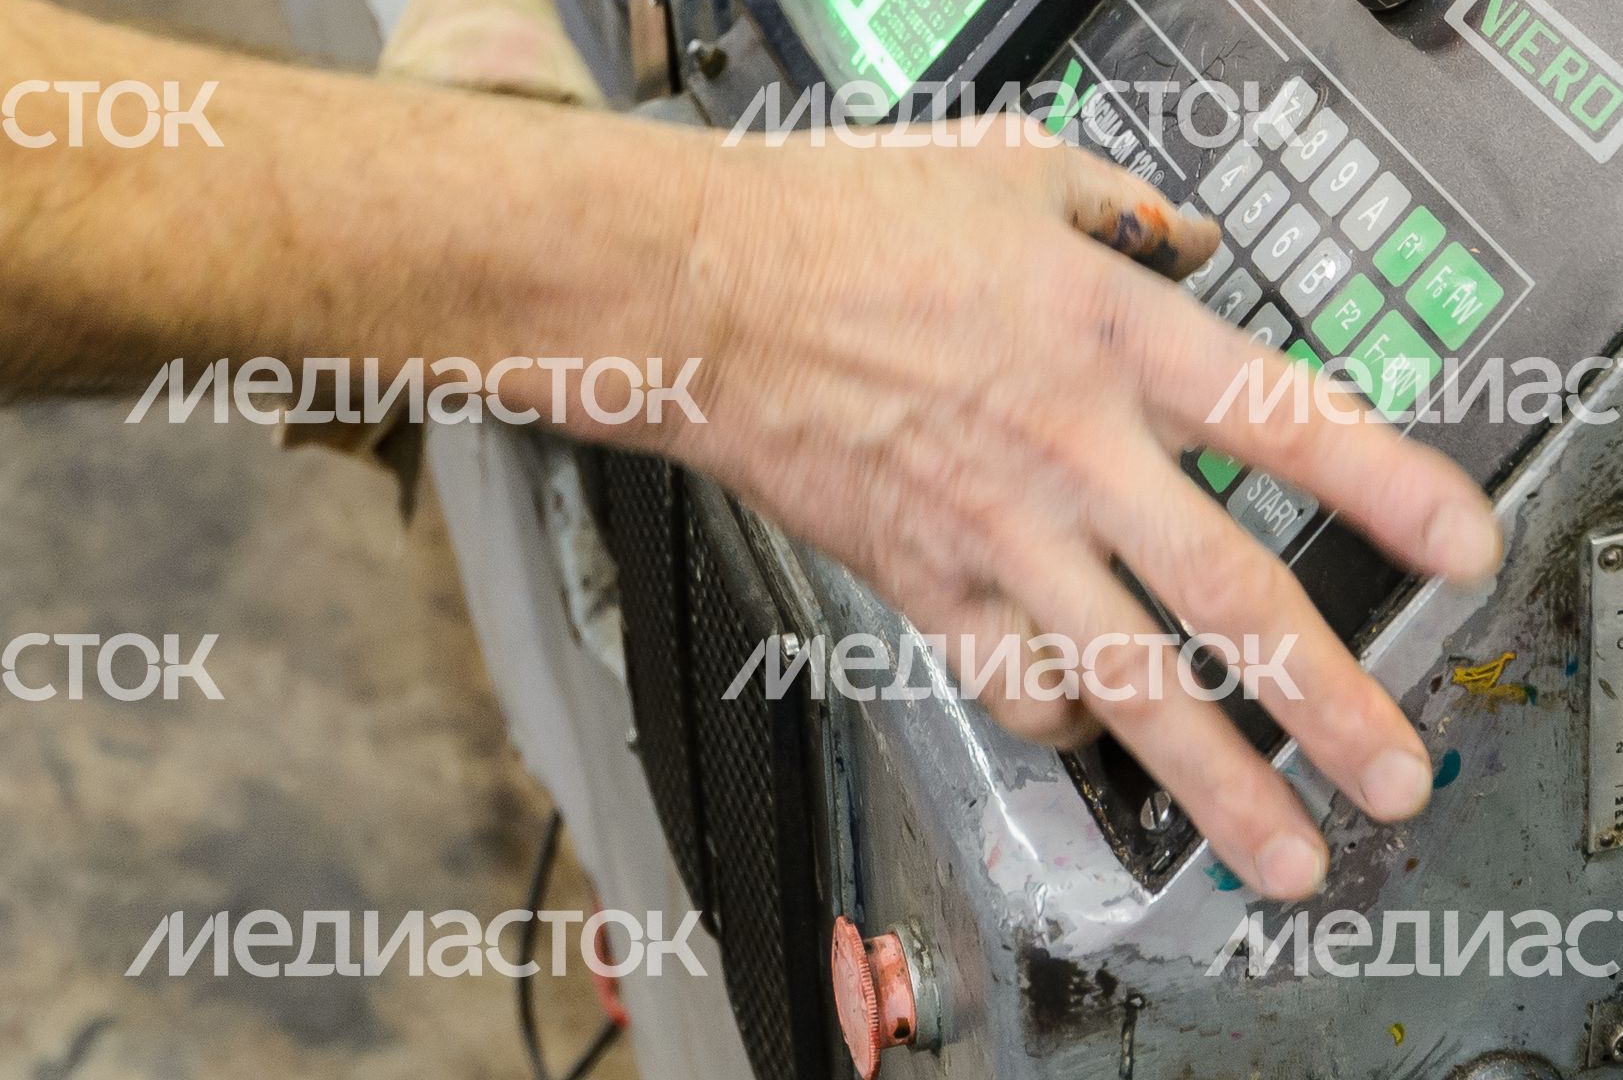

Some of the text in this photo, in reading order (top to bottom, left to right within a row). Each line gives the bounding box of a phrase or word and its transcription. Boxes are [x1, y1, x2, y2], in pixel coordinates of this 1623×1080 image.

[1277, 95, 1302, 124] 7
[1081, 92, 1123, 147] SIGMA
[1110, 129, 1140, 165] CN
[1300, 129, 1328, 160] 8
[1219, 163, 1245, 192] 4
[1329, 161, 1358, 192] 9
[1243, 192, 1272, 224] 5
[1358, 196, 1389, 231] A
[1271, 227, 1300, 258] 6
[1299, 258, 1331, 294] B
[1334, 299, 1362, 331] F2
[1246, 472, 1303, 537] START
